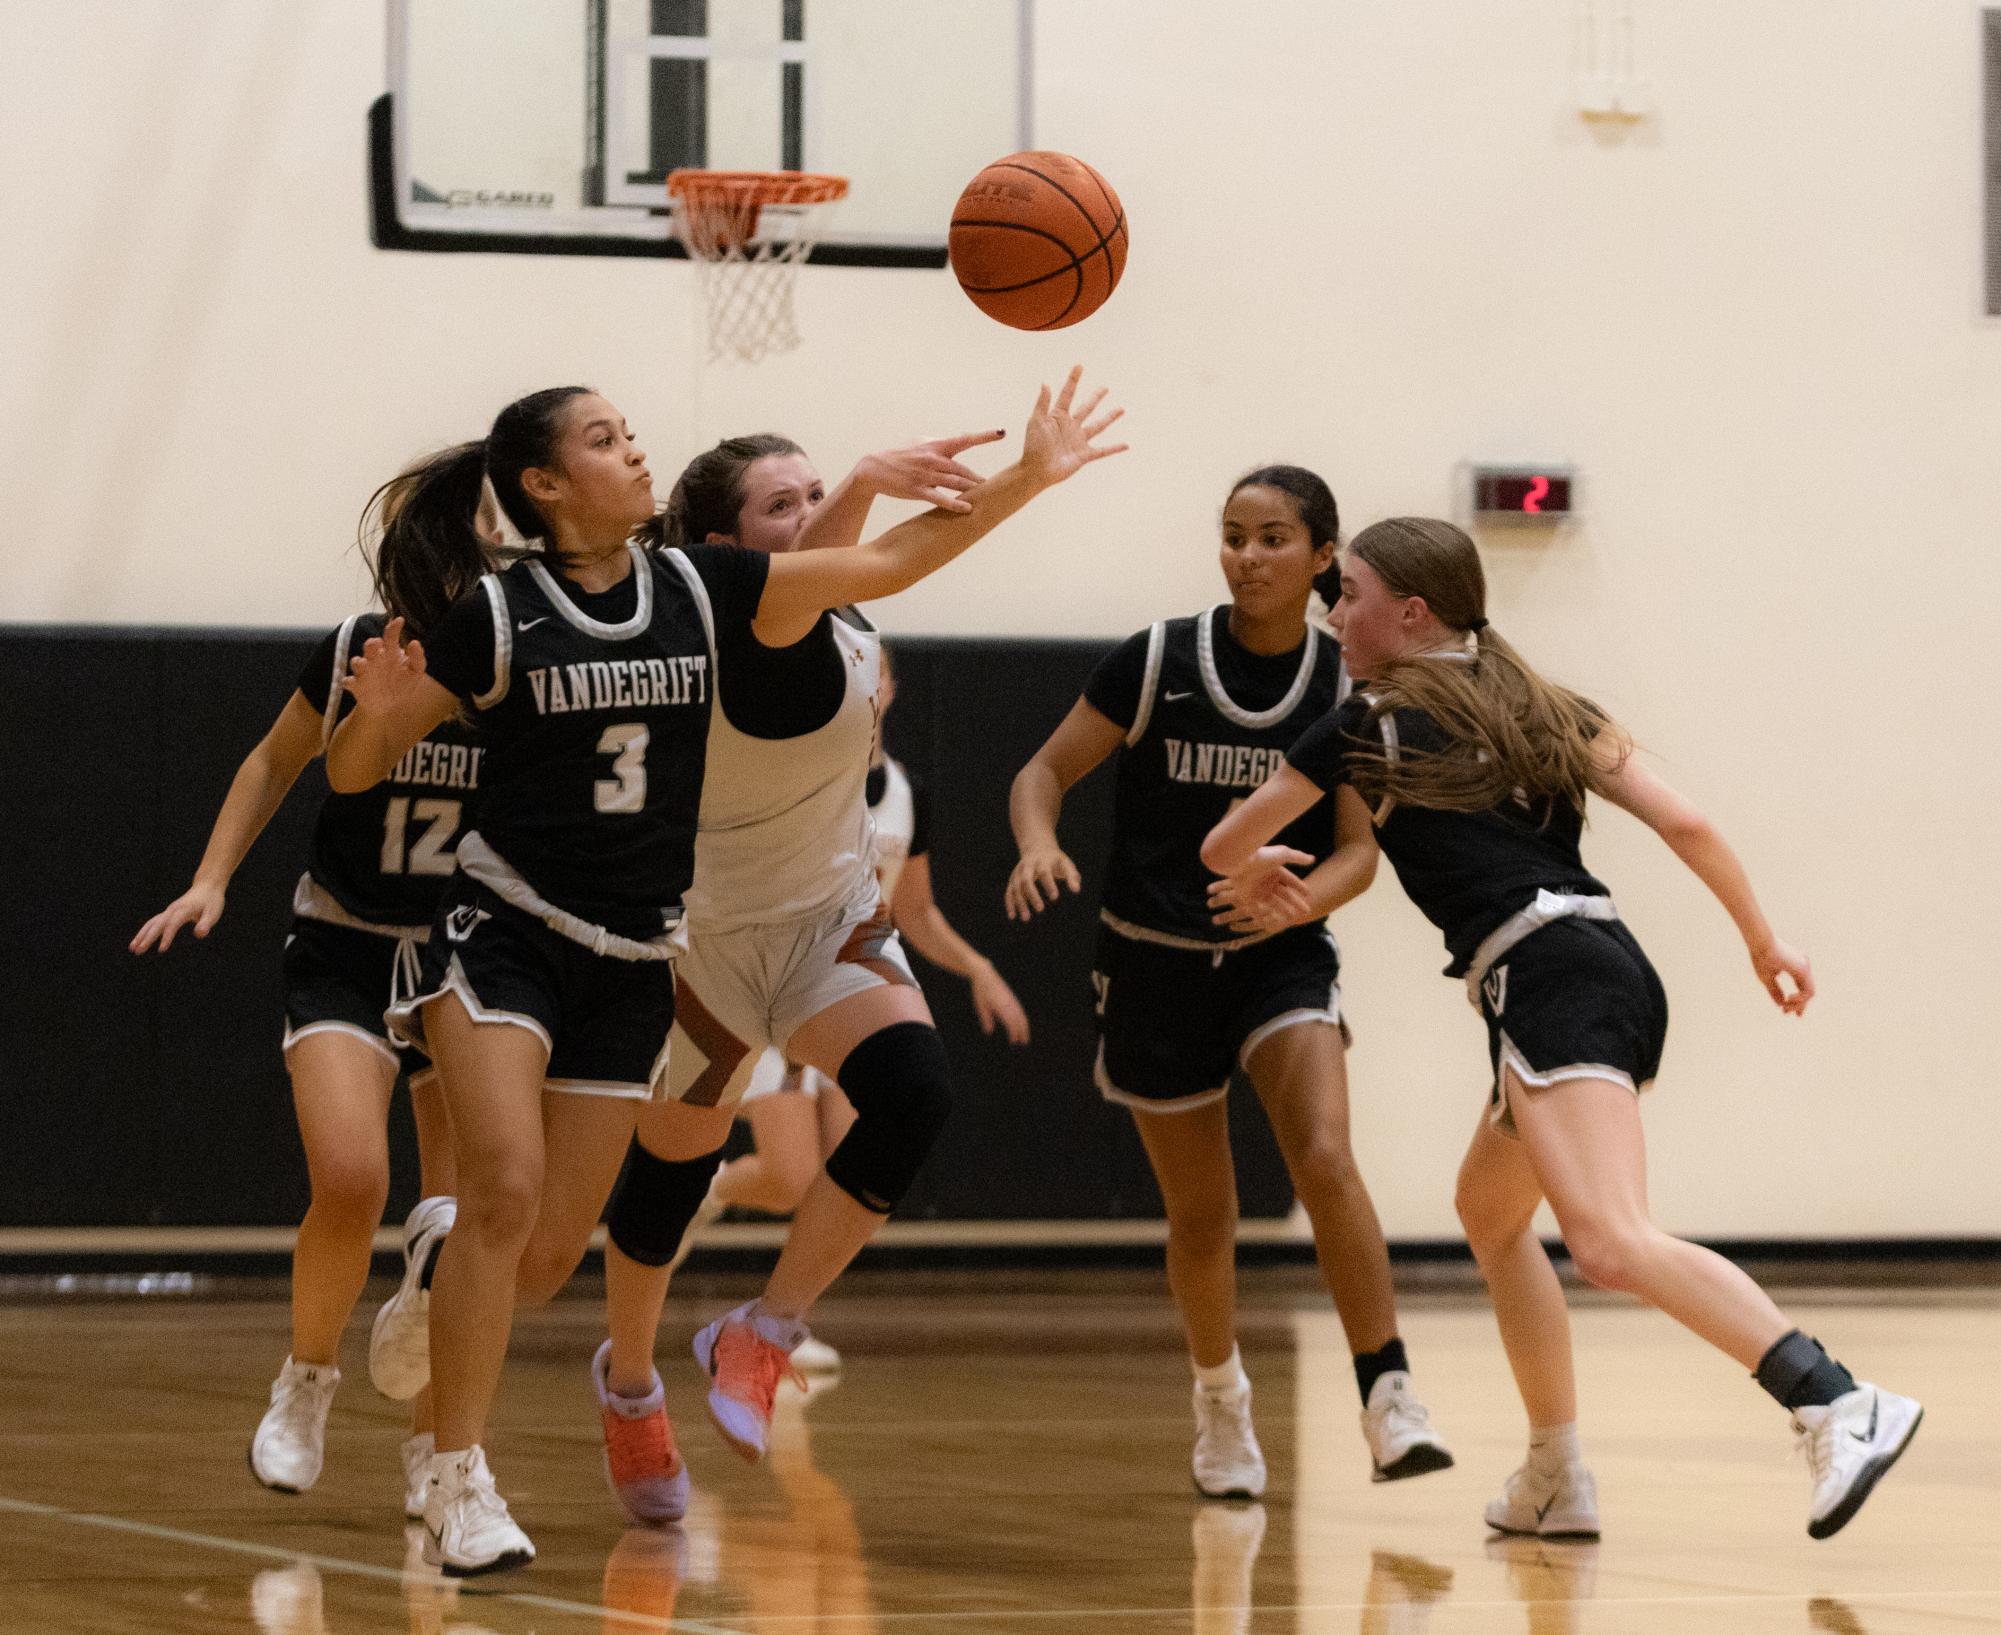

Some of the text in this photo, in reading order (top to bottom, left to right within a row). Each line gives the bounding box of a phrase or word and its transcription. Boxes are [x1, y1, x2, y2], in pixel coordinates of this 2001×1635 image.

[1523, 475, 1549, 512] 2
[527, 655, 706, 715] VANDEGRIFT
[594, 722, 650, 814] 3
[380, 796, 463, 876] 12
